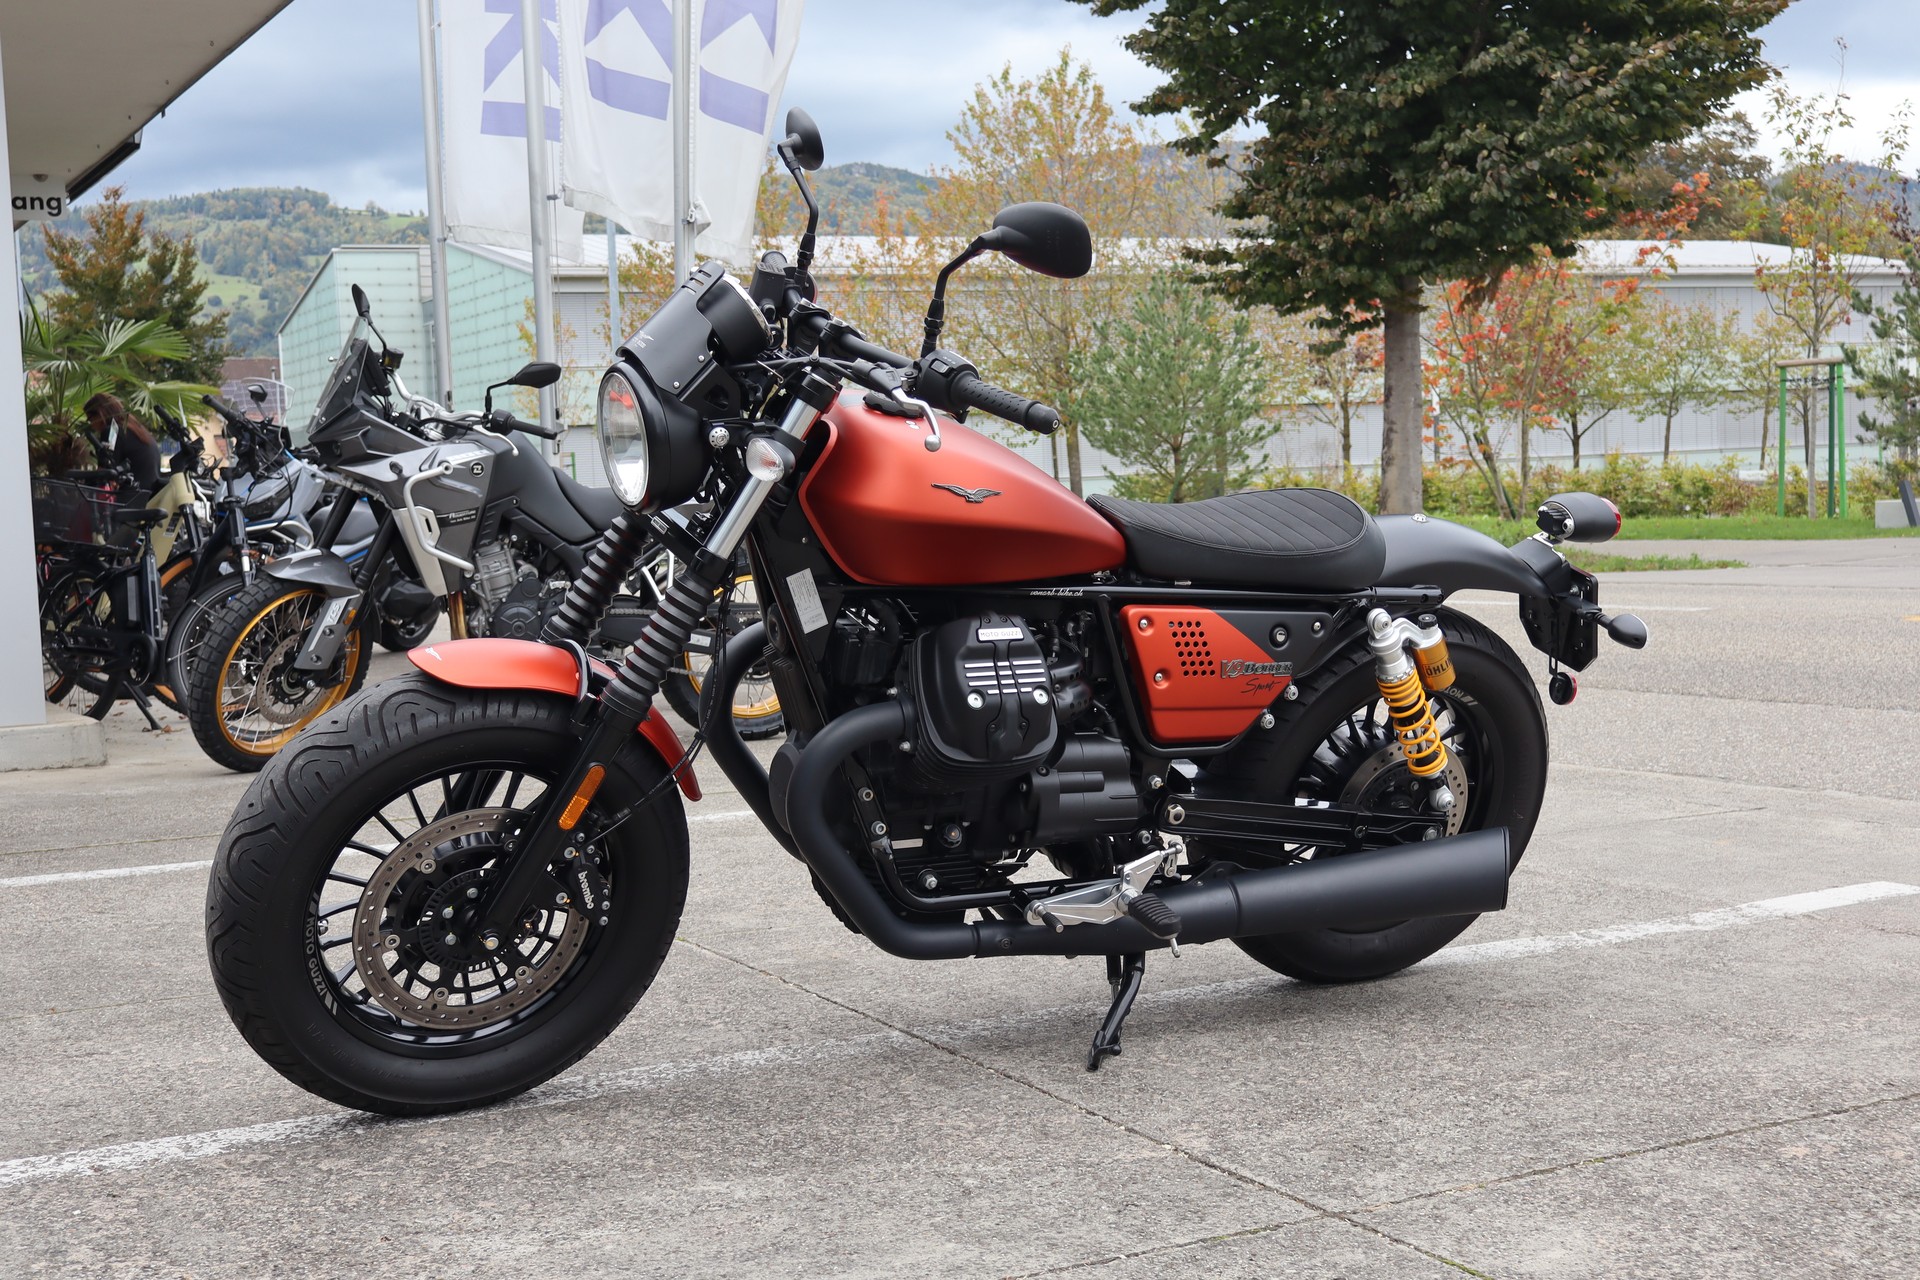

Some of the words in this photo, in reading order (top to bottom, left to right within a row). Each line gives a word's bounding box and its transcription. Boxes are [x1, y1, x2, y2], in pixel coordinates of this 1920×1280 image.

[11, 196, 62, 217] ang
[1438, 685, 1464, 699] MOT
[577, 870, 594, 909] brembo
[305, 916, 315, 955] MOTO
[308, 957, 328, 997] GUZZI
